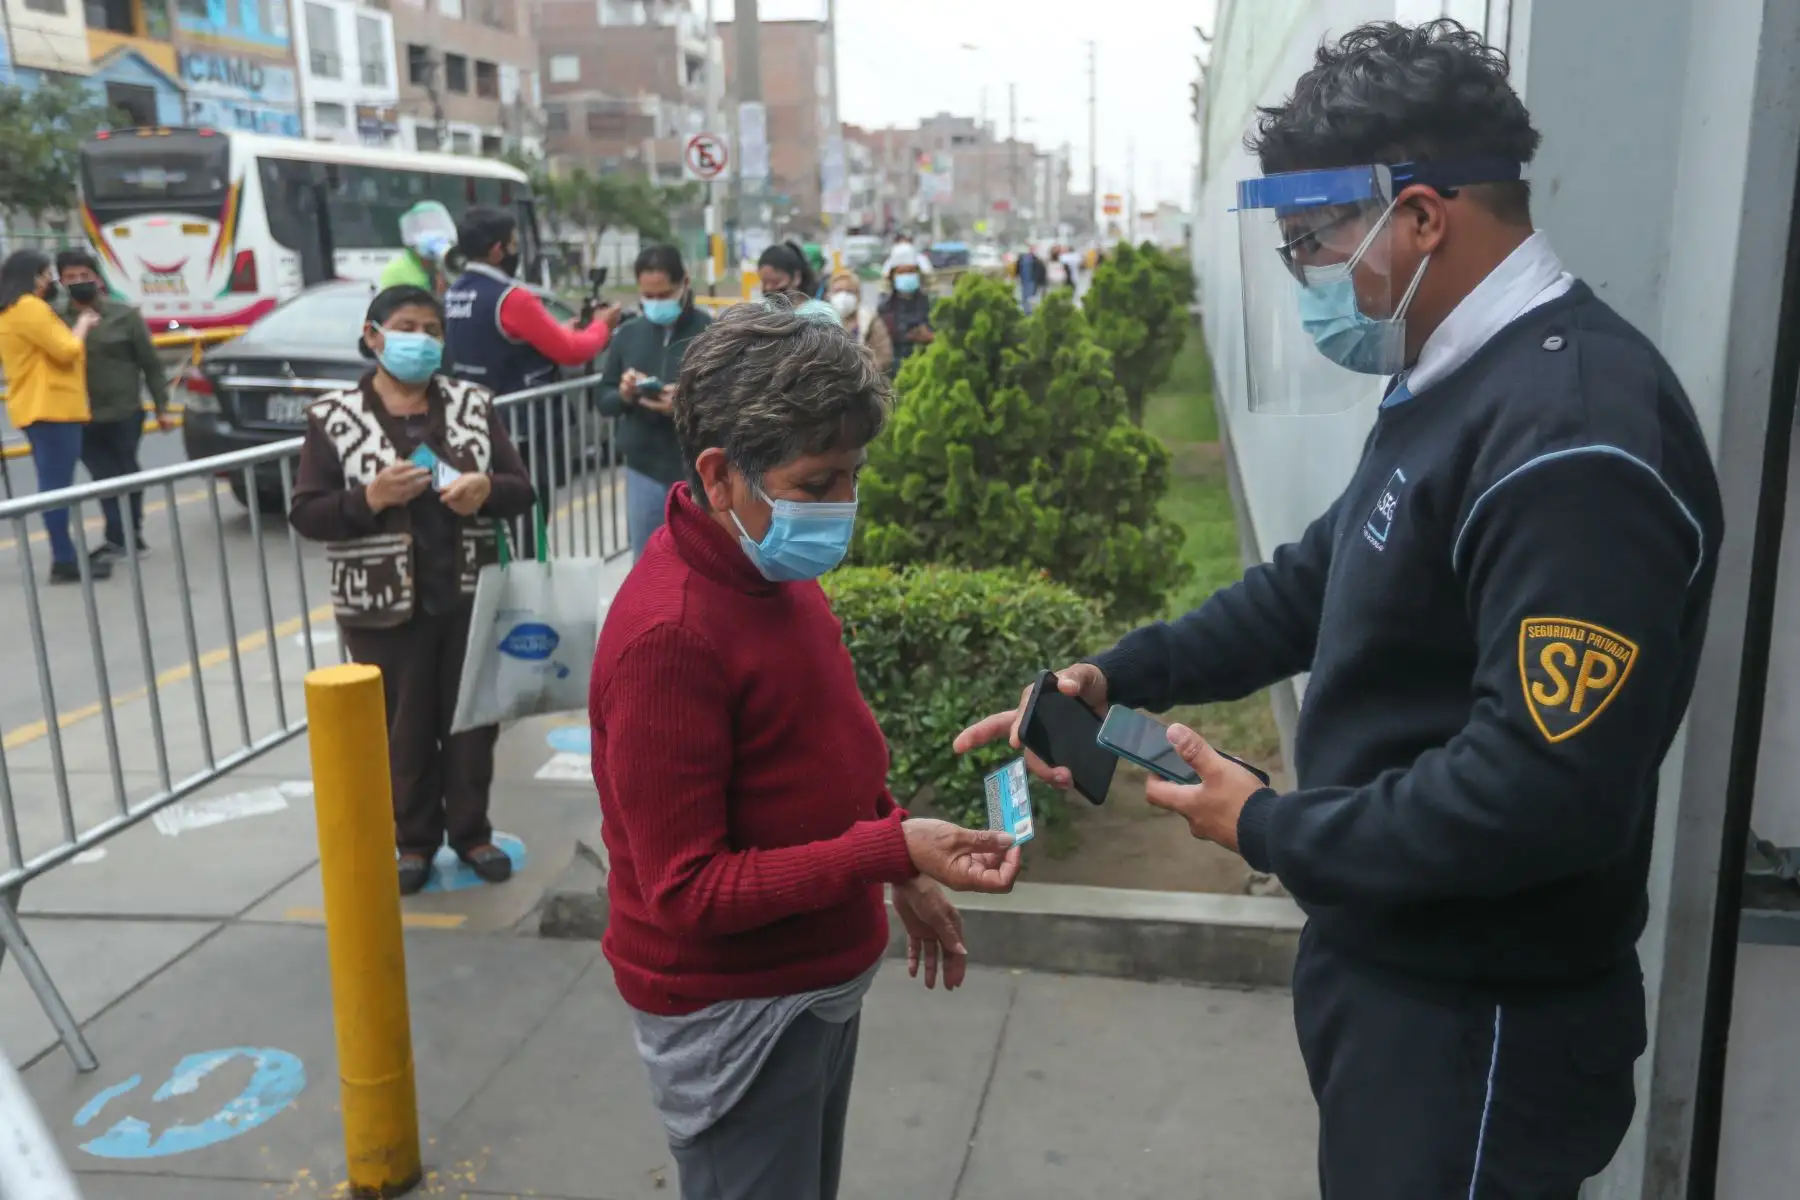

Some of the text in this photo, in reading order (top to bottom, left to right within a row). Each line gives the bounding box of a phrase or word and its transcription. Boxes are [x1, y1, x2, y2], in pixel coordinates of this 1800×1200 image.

[699, 142, 715, 168] E
[1527, 624, 1631, 663] SEGURIDAD PRIVADA
[1531, 641, 1617, 713] SP
